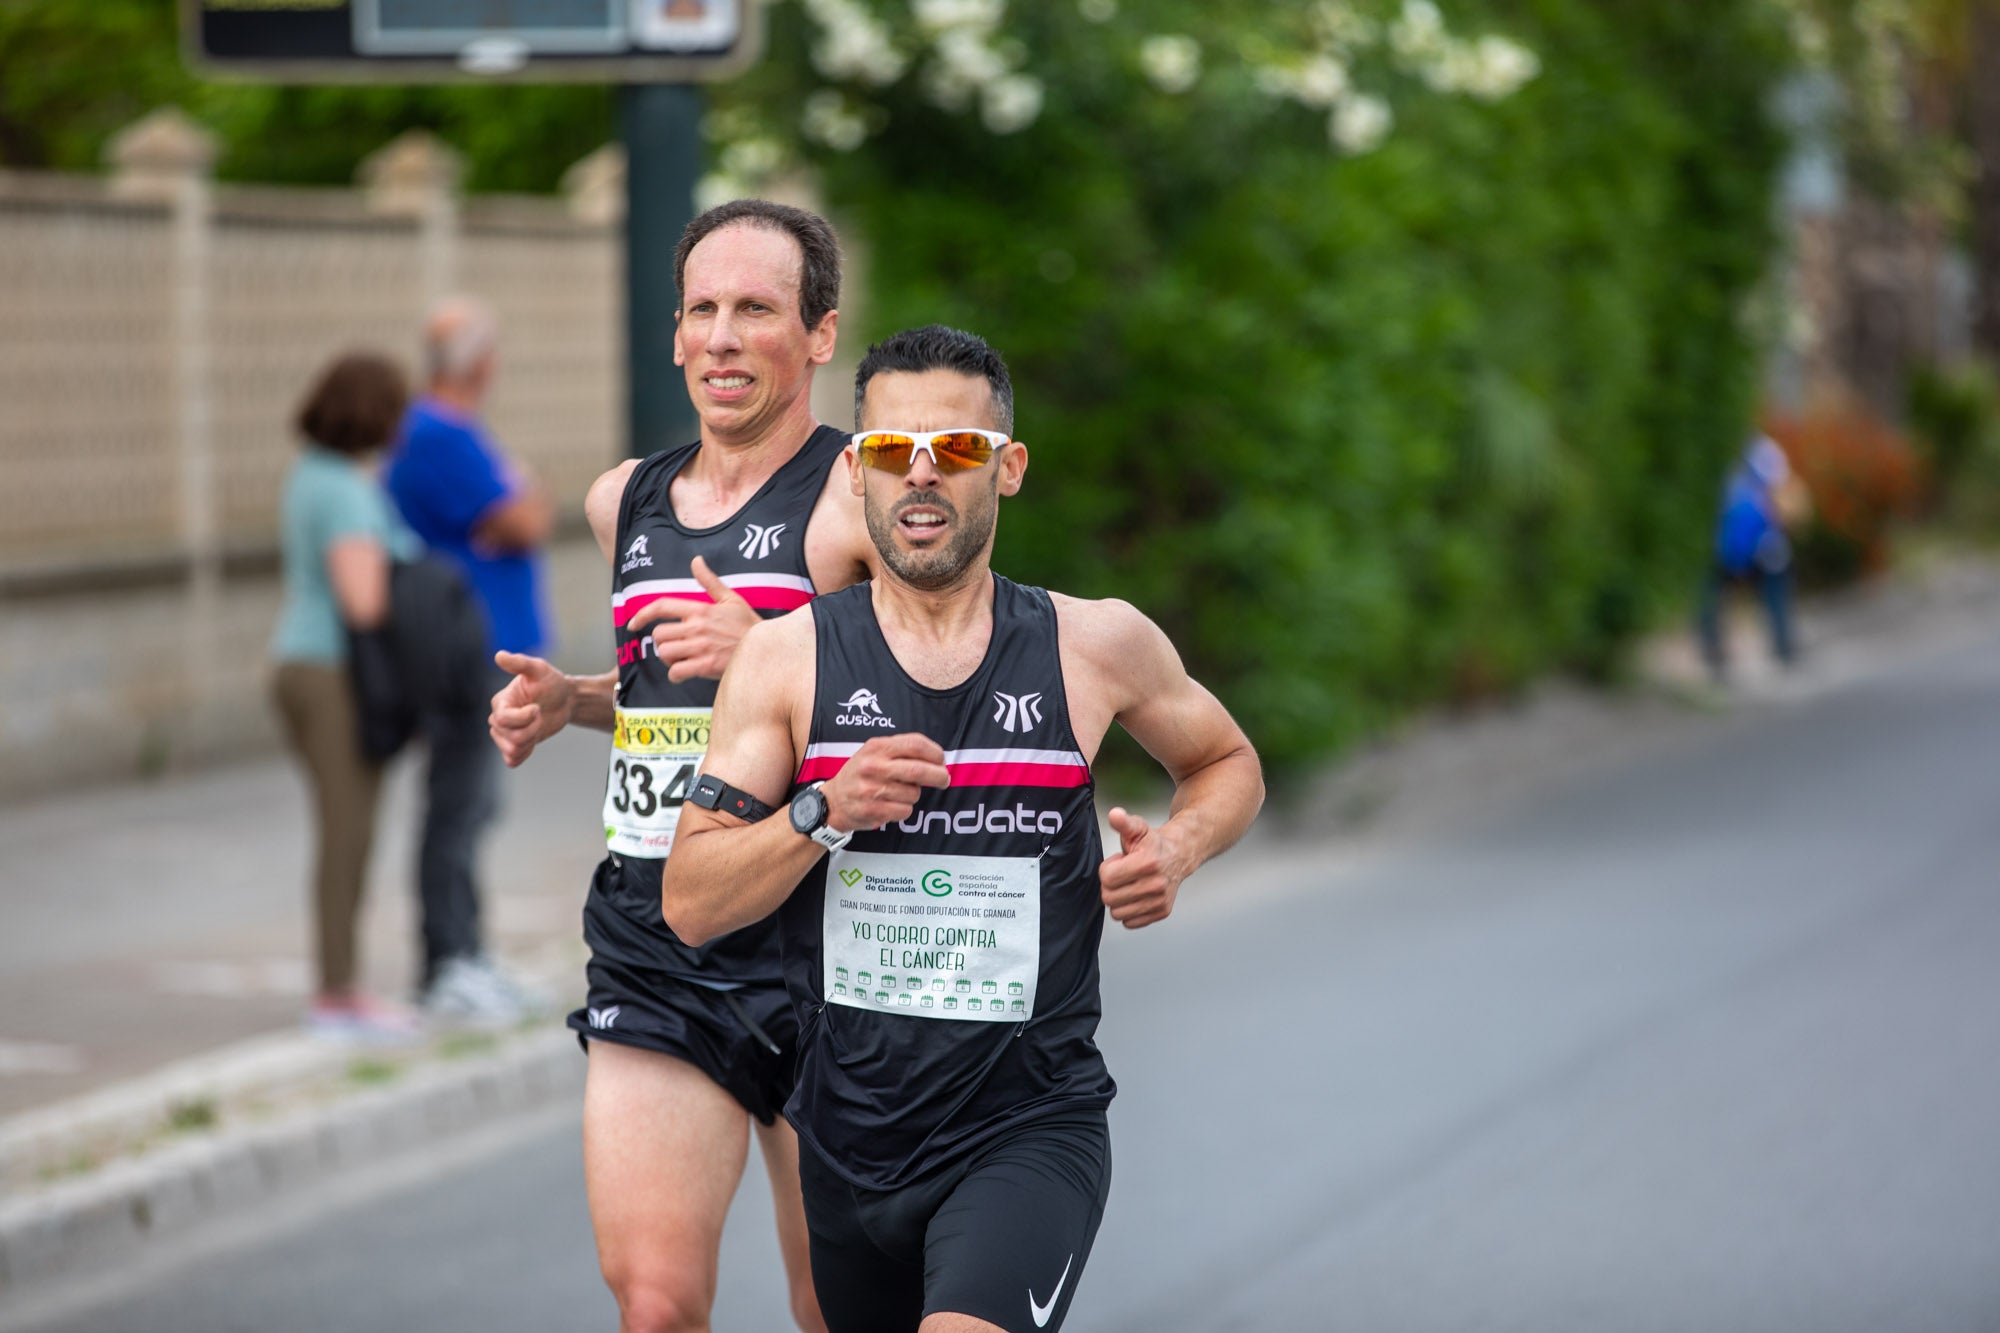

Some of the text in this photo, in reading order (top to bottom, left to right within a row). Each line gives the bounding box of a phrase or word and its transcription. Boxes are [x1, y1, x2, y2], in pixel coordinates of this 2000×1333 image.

[661, 717, 704, 727] PREMIO
[835, 714, 896, 728] austral
[613, 758, 696, 817] 334
[865, 875, 914, 885] Diputación
[958, 873, 1005, 881] asociación
[878, 885, 916, 893] Granada
[958, 882, 998, 890] española
[840, 899, 1016, 919] GRAN PREMIO DE FONDO DIPUTACIÓN DE GRANADA
[852, 921, 997, 948] YO CORRO CONTRA
[880, 948, 965, 971] EL CÁNCER
